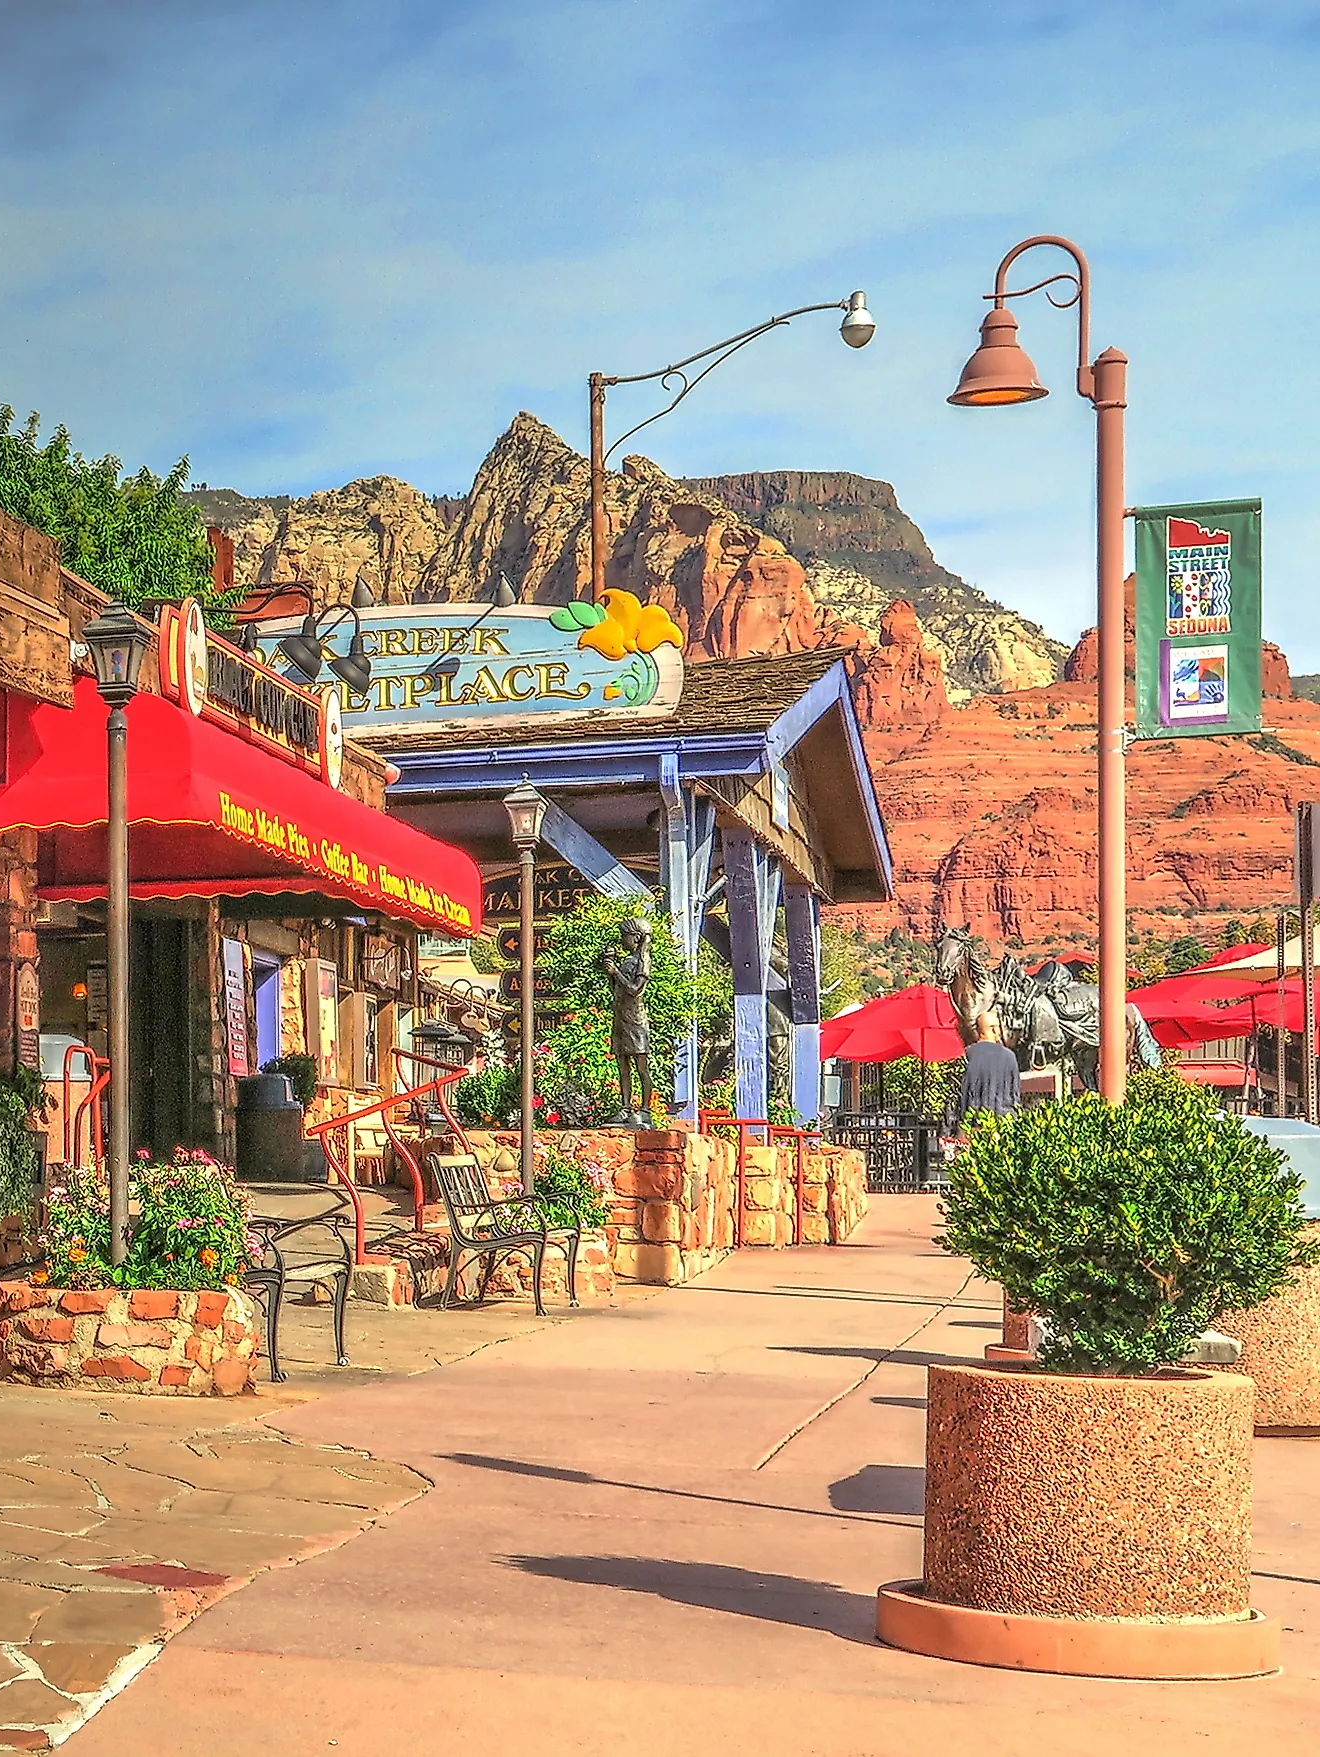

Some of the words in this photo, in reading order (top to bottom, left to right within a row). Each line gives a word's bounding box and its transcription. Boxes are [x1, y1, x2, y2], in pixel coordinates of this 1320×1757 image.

[1168, 546, 1229, 562] MAIN
[1168, 557, 1229, 573] STREET
[1168, 616, 1229, 635] SEDONA
[363, 627, 509, 656] CREEK
[219, 791, 255, 837] Home
[255, 808, 287, 850] Made
[286, 822, 311, 860] Pies
[320, 838, 351, 879] Coffee
[350, 851, 369, 886] Bar
[378, 864, 408, 901] Home
[405, 876, 432, 911] Made
[429, 887, 445, 916] Ice
[443, 893, 472, 927] Cream
[537, 1016, 555, 1030] hai
